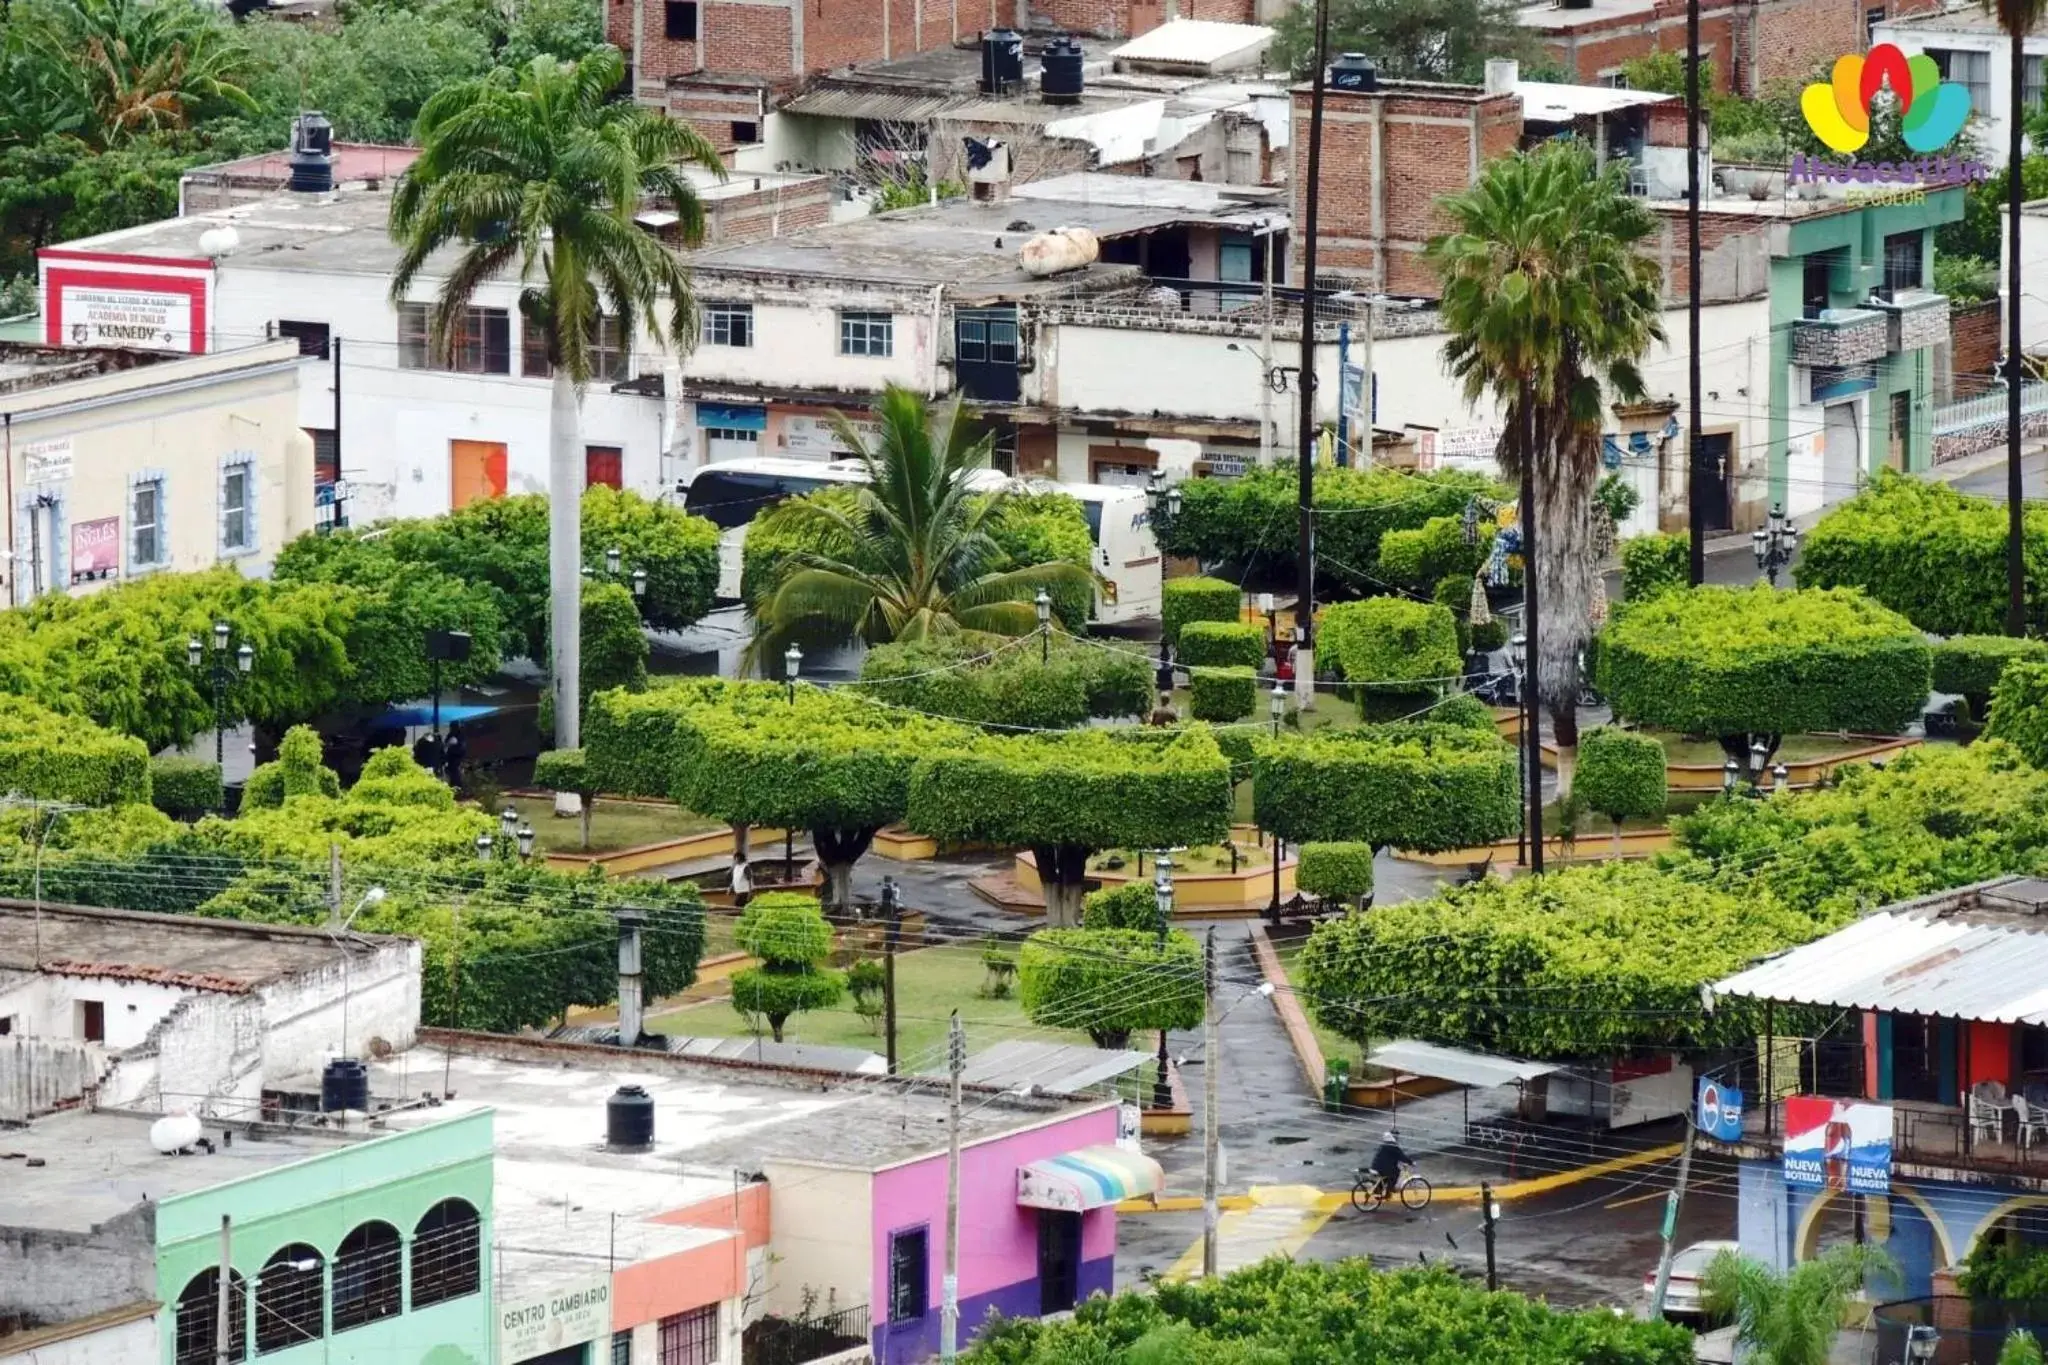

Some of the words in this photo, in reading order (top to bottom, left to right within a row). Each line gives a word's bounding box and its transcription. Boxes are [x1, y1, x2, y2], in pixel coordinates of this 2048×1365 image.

[88, 310, 127, 322] ACADEMIA
[1784, 1158, 1822, 1173] NUEVA
[1784, 1171, 1823, 1184] BOTELLA
[1851, 1167, 1888, 1179] NUEVA
[1851, 1178, 1888, 1190] IMAGEN
[504, 1304, 545, 1330] CENTRO
[551, 1285, 607, 1317] CAMBIARIO
